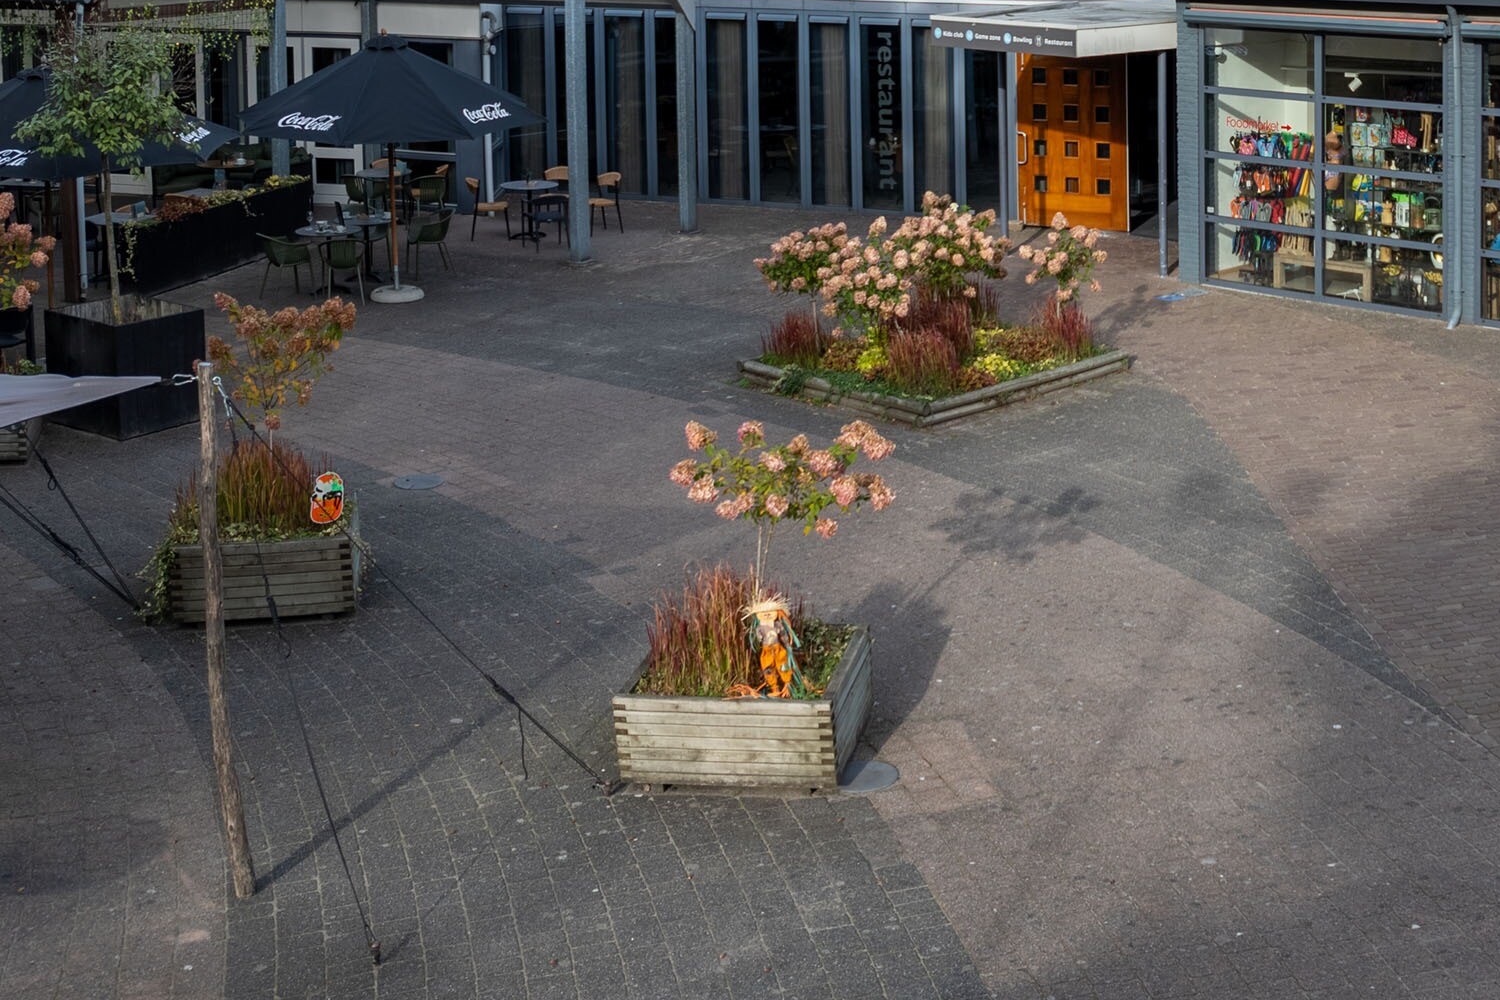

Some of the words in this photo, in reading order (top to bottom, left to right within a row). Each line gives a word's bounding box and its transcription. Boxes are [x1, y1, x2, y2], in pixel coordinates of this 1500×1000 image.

[974, 33, 989, 41] Game
[1013, 35, 1033, 45] Bowling
[1044, 37, 1074, 47] Restaurant
[877, 31, 898, 190] restaurant
[1226, 116, 1279, 132] Foodmarket
